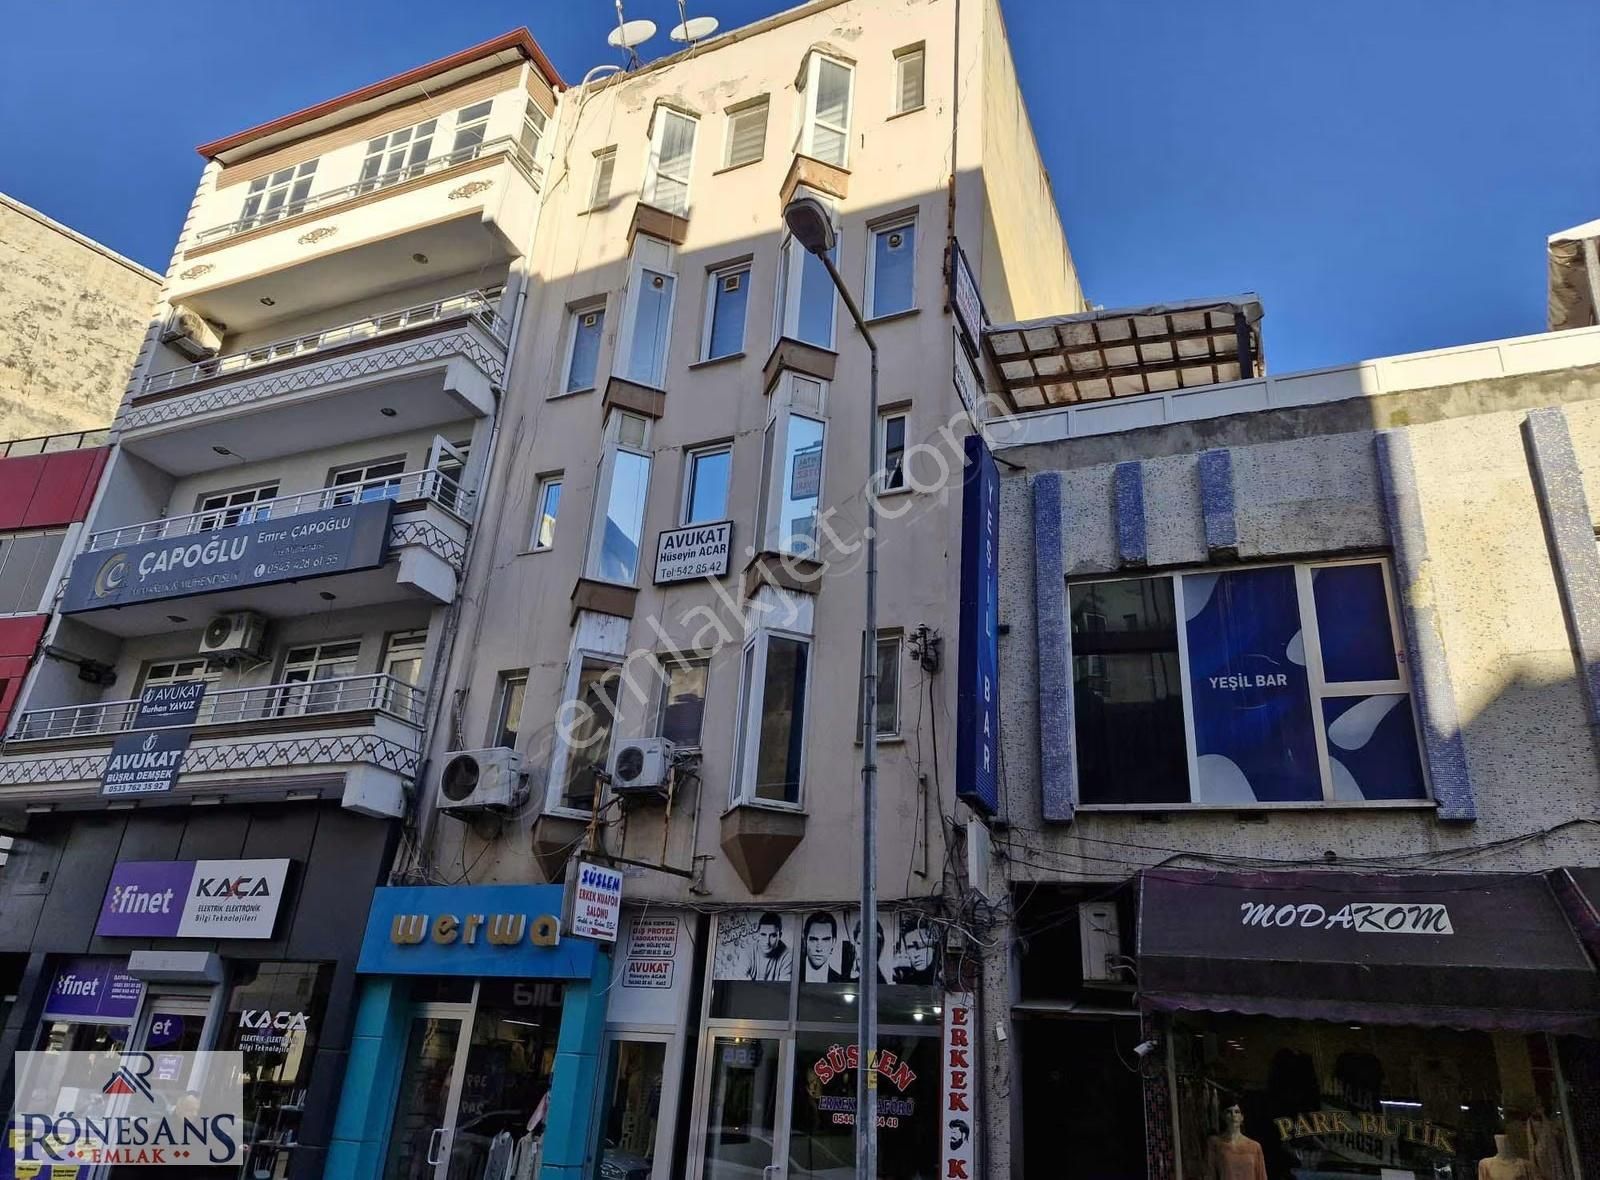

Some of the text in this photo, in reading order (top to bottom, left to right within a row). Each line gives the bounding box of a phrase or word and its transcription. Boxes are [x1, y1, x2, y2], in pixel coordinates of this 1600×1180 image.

[257, 530, 287, 543] Emre
[664, 528, 726, 549] AVUKAT
[139, 535, 249, 582] ÇAPOĞLU
[660, 544, 726, 562] Hüseyin ACAR
[696, 563, 707, 574] 85
[710, 561, 721, 571] 42
[1209, 673, 1288, 691] YEŞİL BAR
[154, 684, 204, 701] AVUKAT
[141, 701, 195, 713] Burhan YAVUZ
[983, 675, 991, 773] BAR
[109, 750, 182, 771] AVUKAT
[106, 769, 173, 783] BÜŞRA DEMŞEK
[196, 876, 270, 900] KAÇA
[582, 867, 619, 891] SÜSLEN
[579, 889, 597, 902] ERKEK
[195, 914, 257, 923] Bilgi Teknolojileri
[1241, 901, 1448, 932] MODAKOM
[390, 913, 561, 946] werwa
[628, 962, 670, 973] AVUKAT
[948, 1007, 969, 1112] ERKEK
[1274, 1111, 1353, 1141] PARK
[1359, 1112, 1457, 1153] BUTİK
